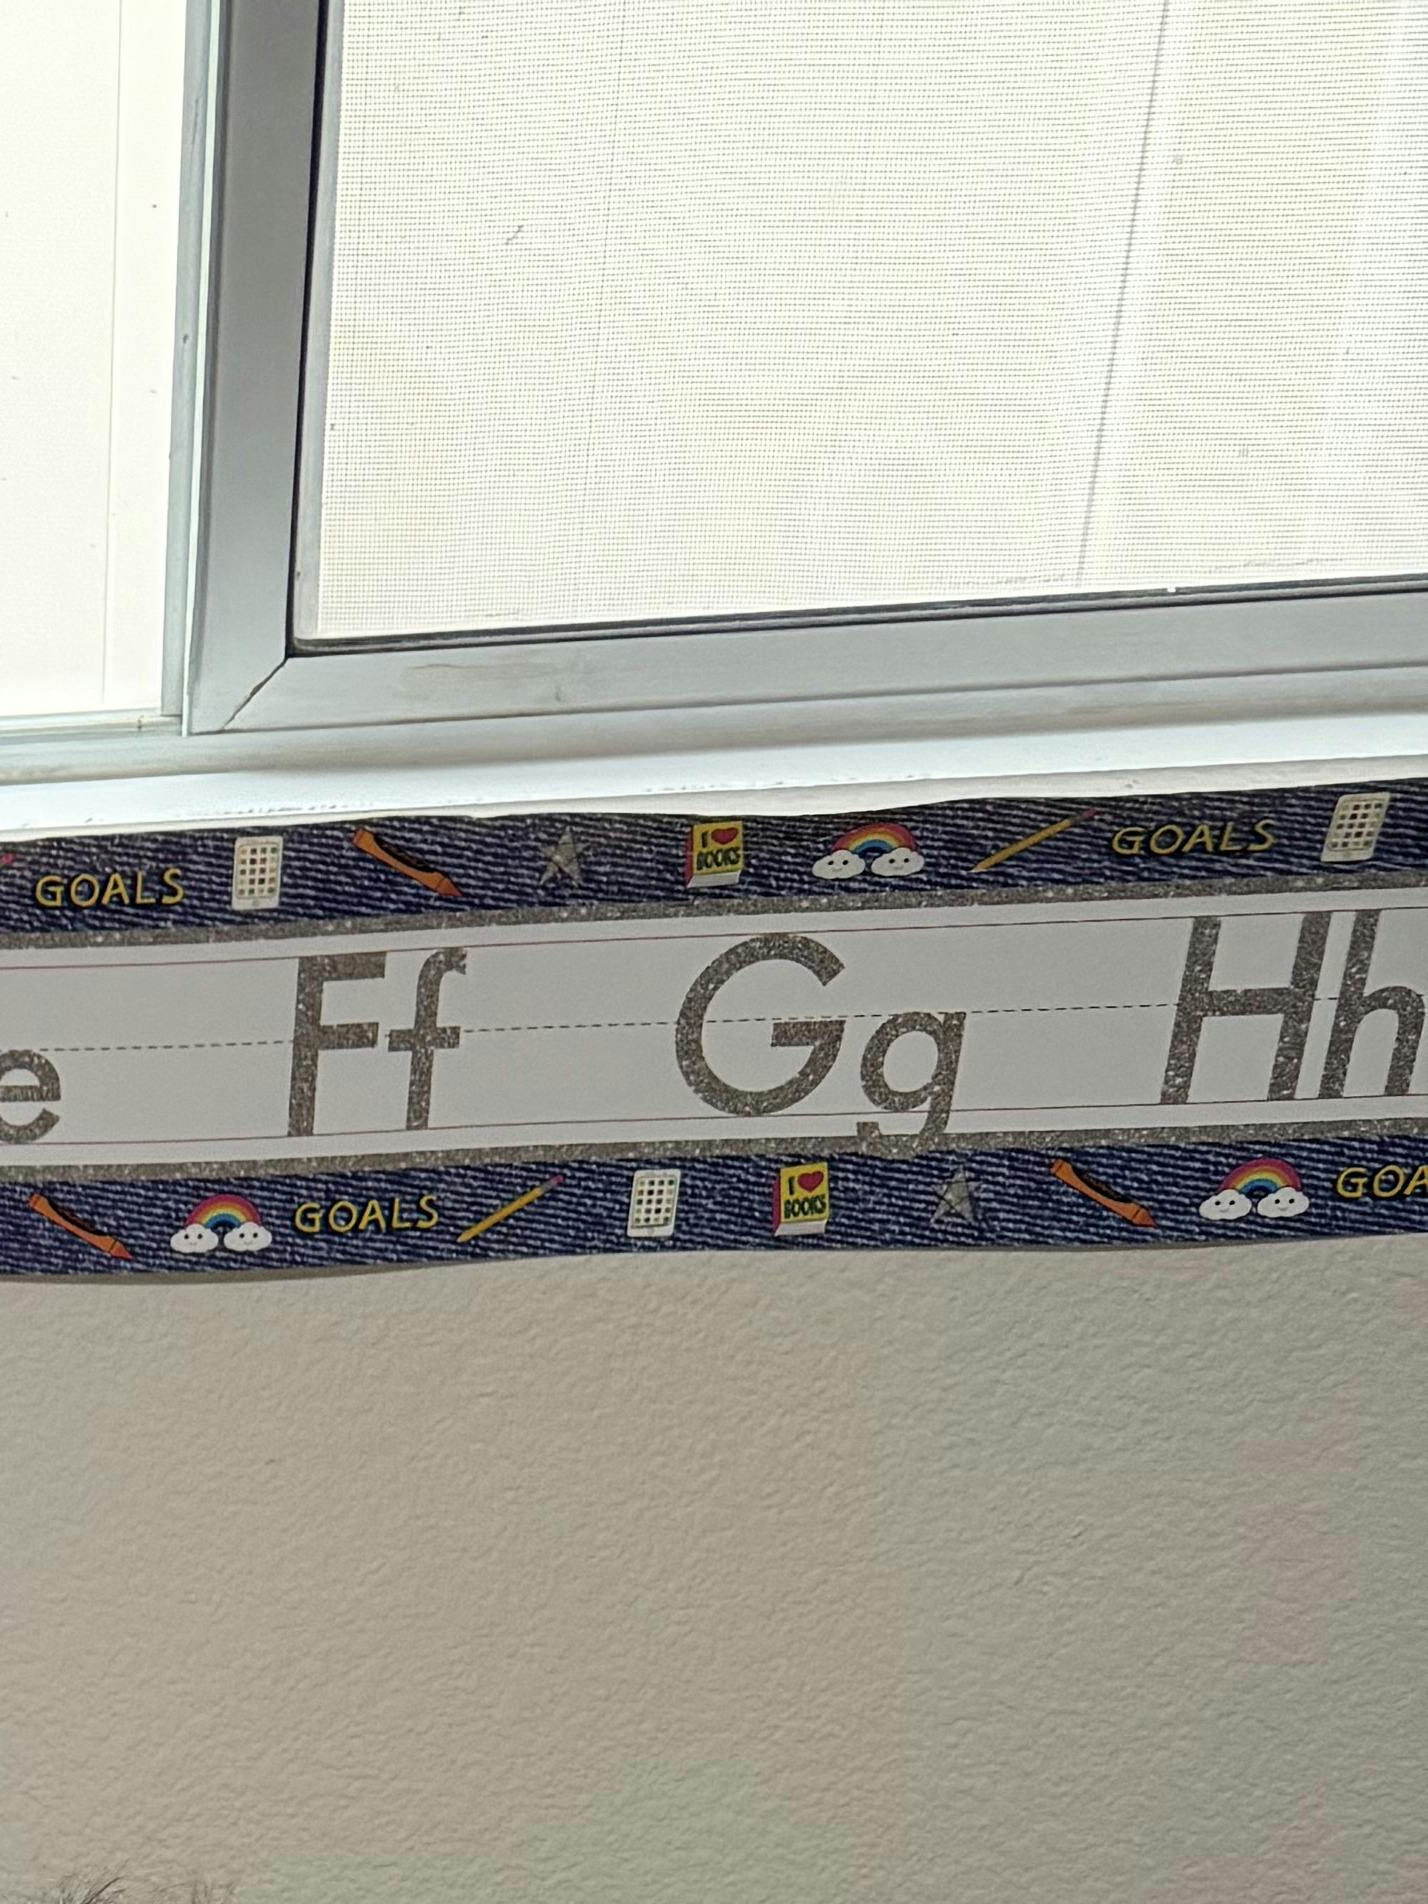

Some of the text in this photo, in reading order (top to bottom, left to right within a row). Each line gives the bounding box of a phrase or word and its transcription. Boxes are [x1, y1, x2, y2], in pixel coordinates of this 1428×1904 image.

[1111, 818, 1276, 856] GOALS
[34, 863, 185, 908] GOALS
[287, 947, 468, 1137] Ff
[675, 932, 966, 1150] Gg
[1160, 909, 1426, 1105] Hh
[294, 1193, 440, 1234] GOALS
